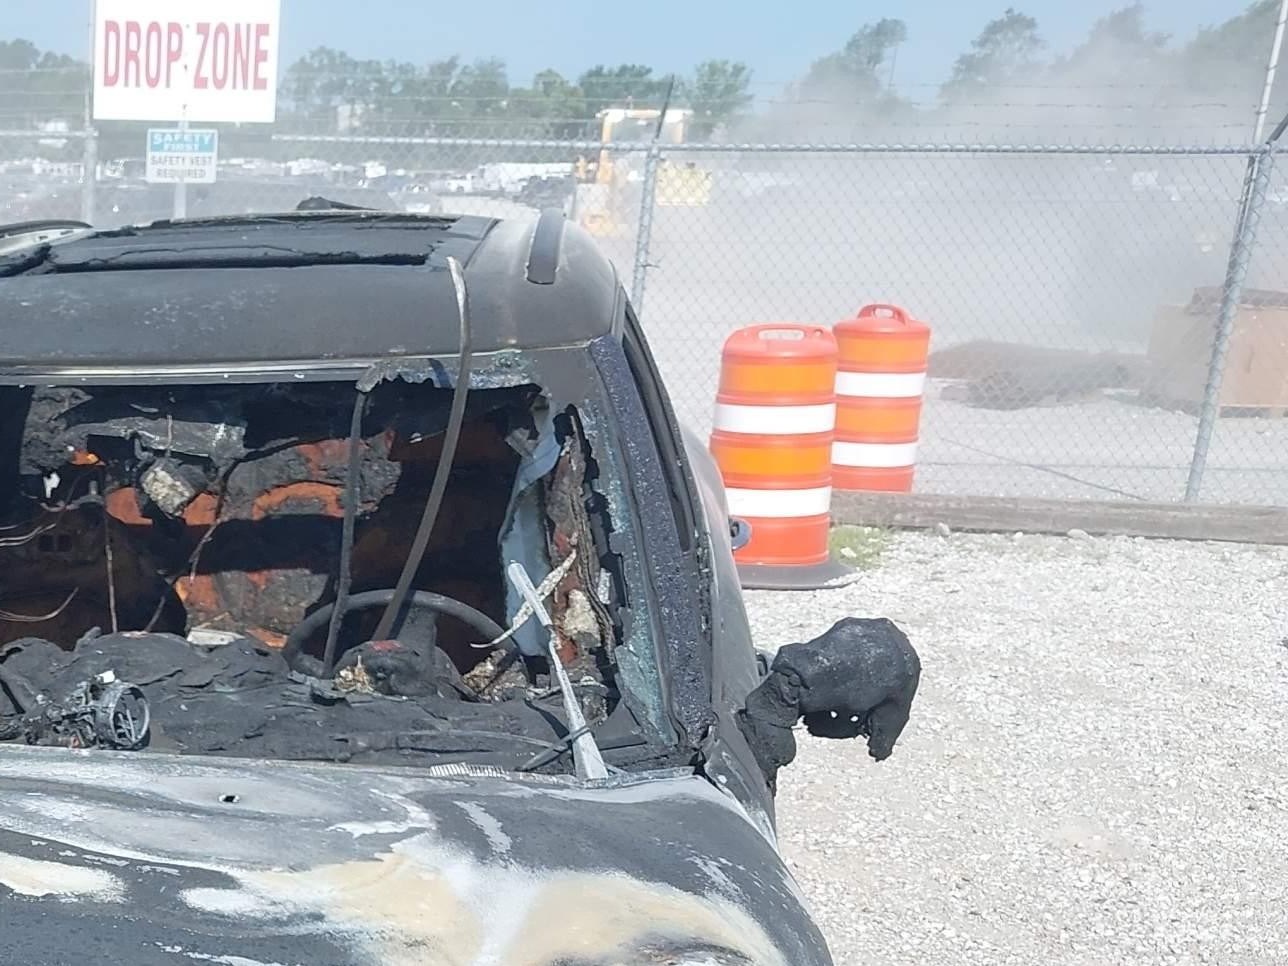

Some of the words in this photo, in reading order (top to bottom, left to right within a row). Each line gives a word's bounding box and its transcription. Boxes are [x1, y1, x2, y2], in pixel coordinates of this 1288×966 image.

[103, 20, 183, 88] DROP
[194, 22, 270, 90] ZONE
[152, 133, 212, 145] SAFETY
[163, 144, 200, 152] FIRST
[151, 156, 186, 166] SAFETY
[190, 156, 212, 166] VEST
[156, 168, 206, 178] REQUIRED
